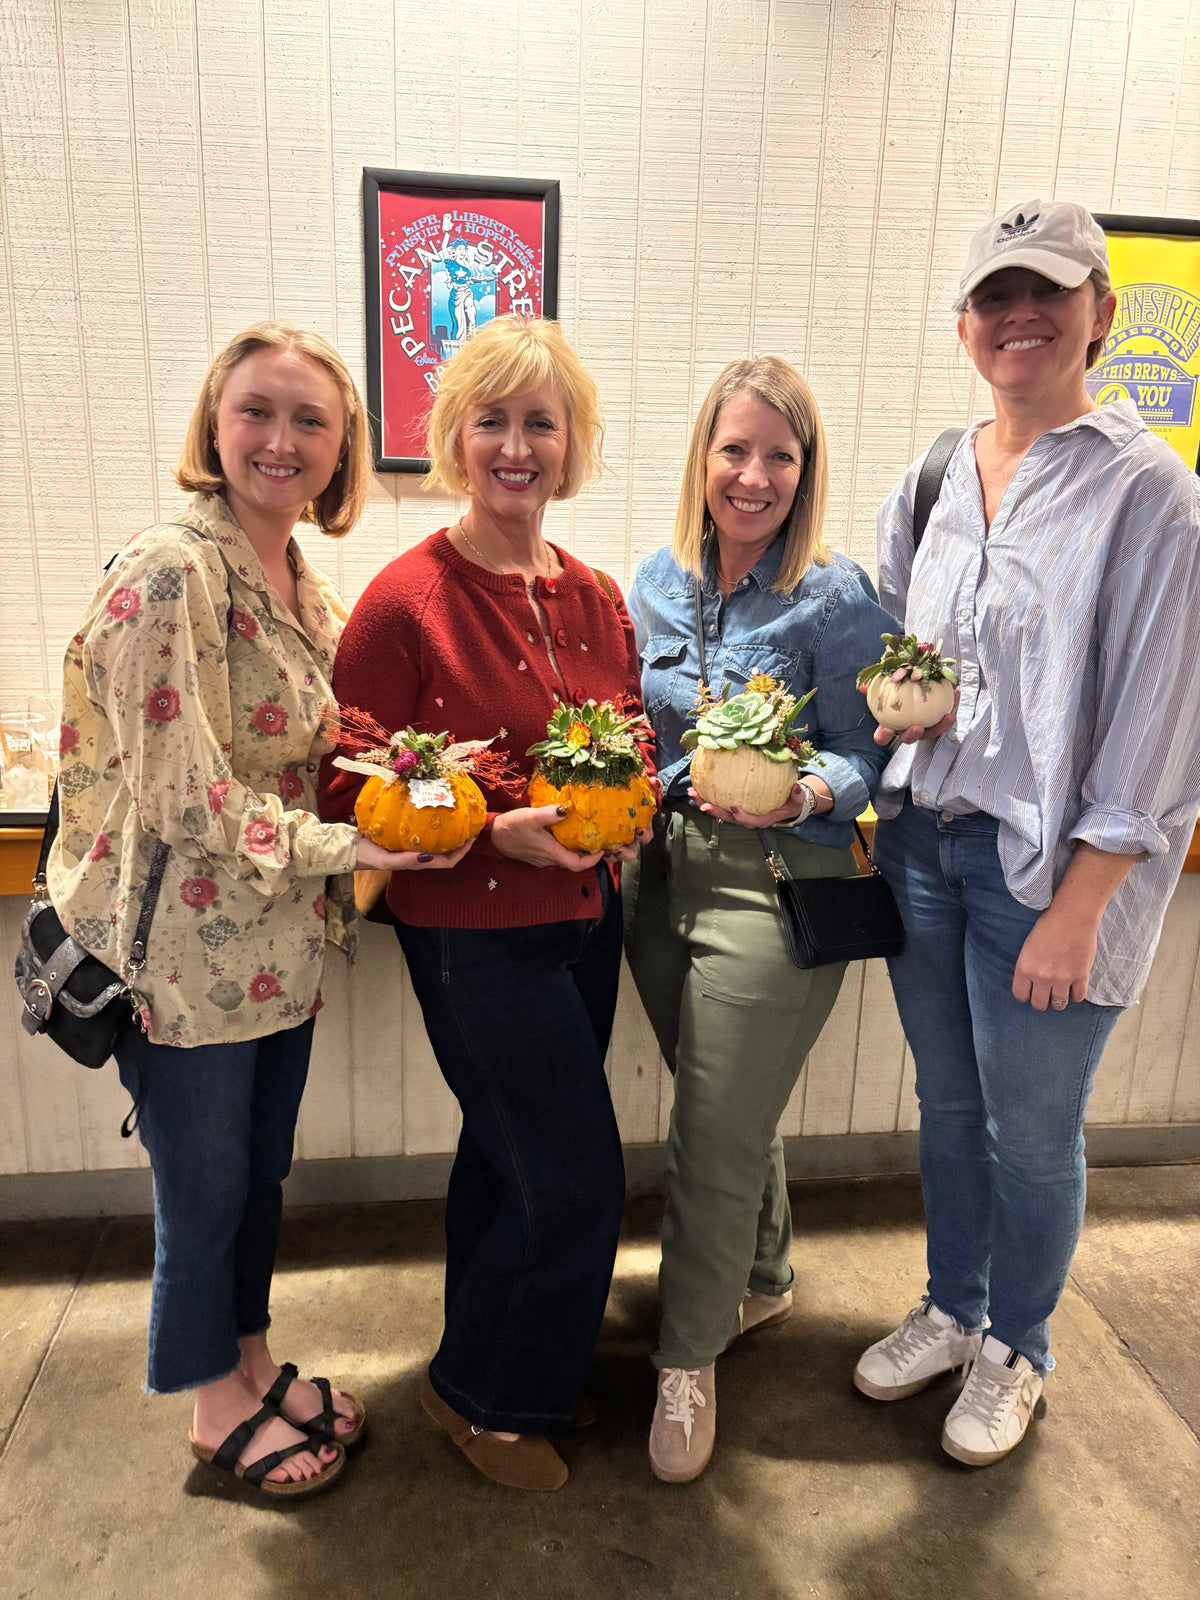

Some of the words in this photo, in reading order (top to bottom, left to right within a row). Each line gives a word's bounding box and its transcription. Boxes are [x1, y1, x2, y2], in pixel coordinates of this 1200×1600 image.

[452, 210, 520, 241] LIBERTY
[385, 225, 441, 267] PURSUIT
[465, 222, 536, 272] HOPPINESS
[388, 240, 443, 360] PECAN
[474, 241, 534, 318] STRE
[1106, 326, 1180, 352] BREWING
[1102, 363, 1133, 379] THIS
[1132, 362, 1178, 381] BREWS
[1137, 385, 1173, 407] YOU
